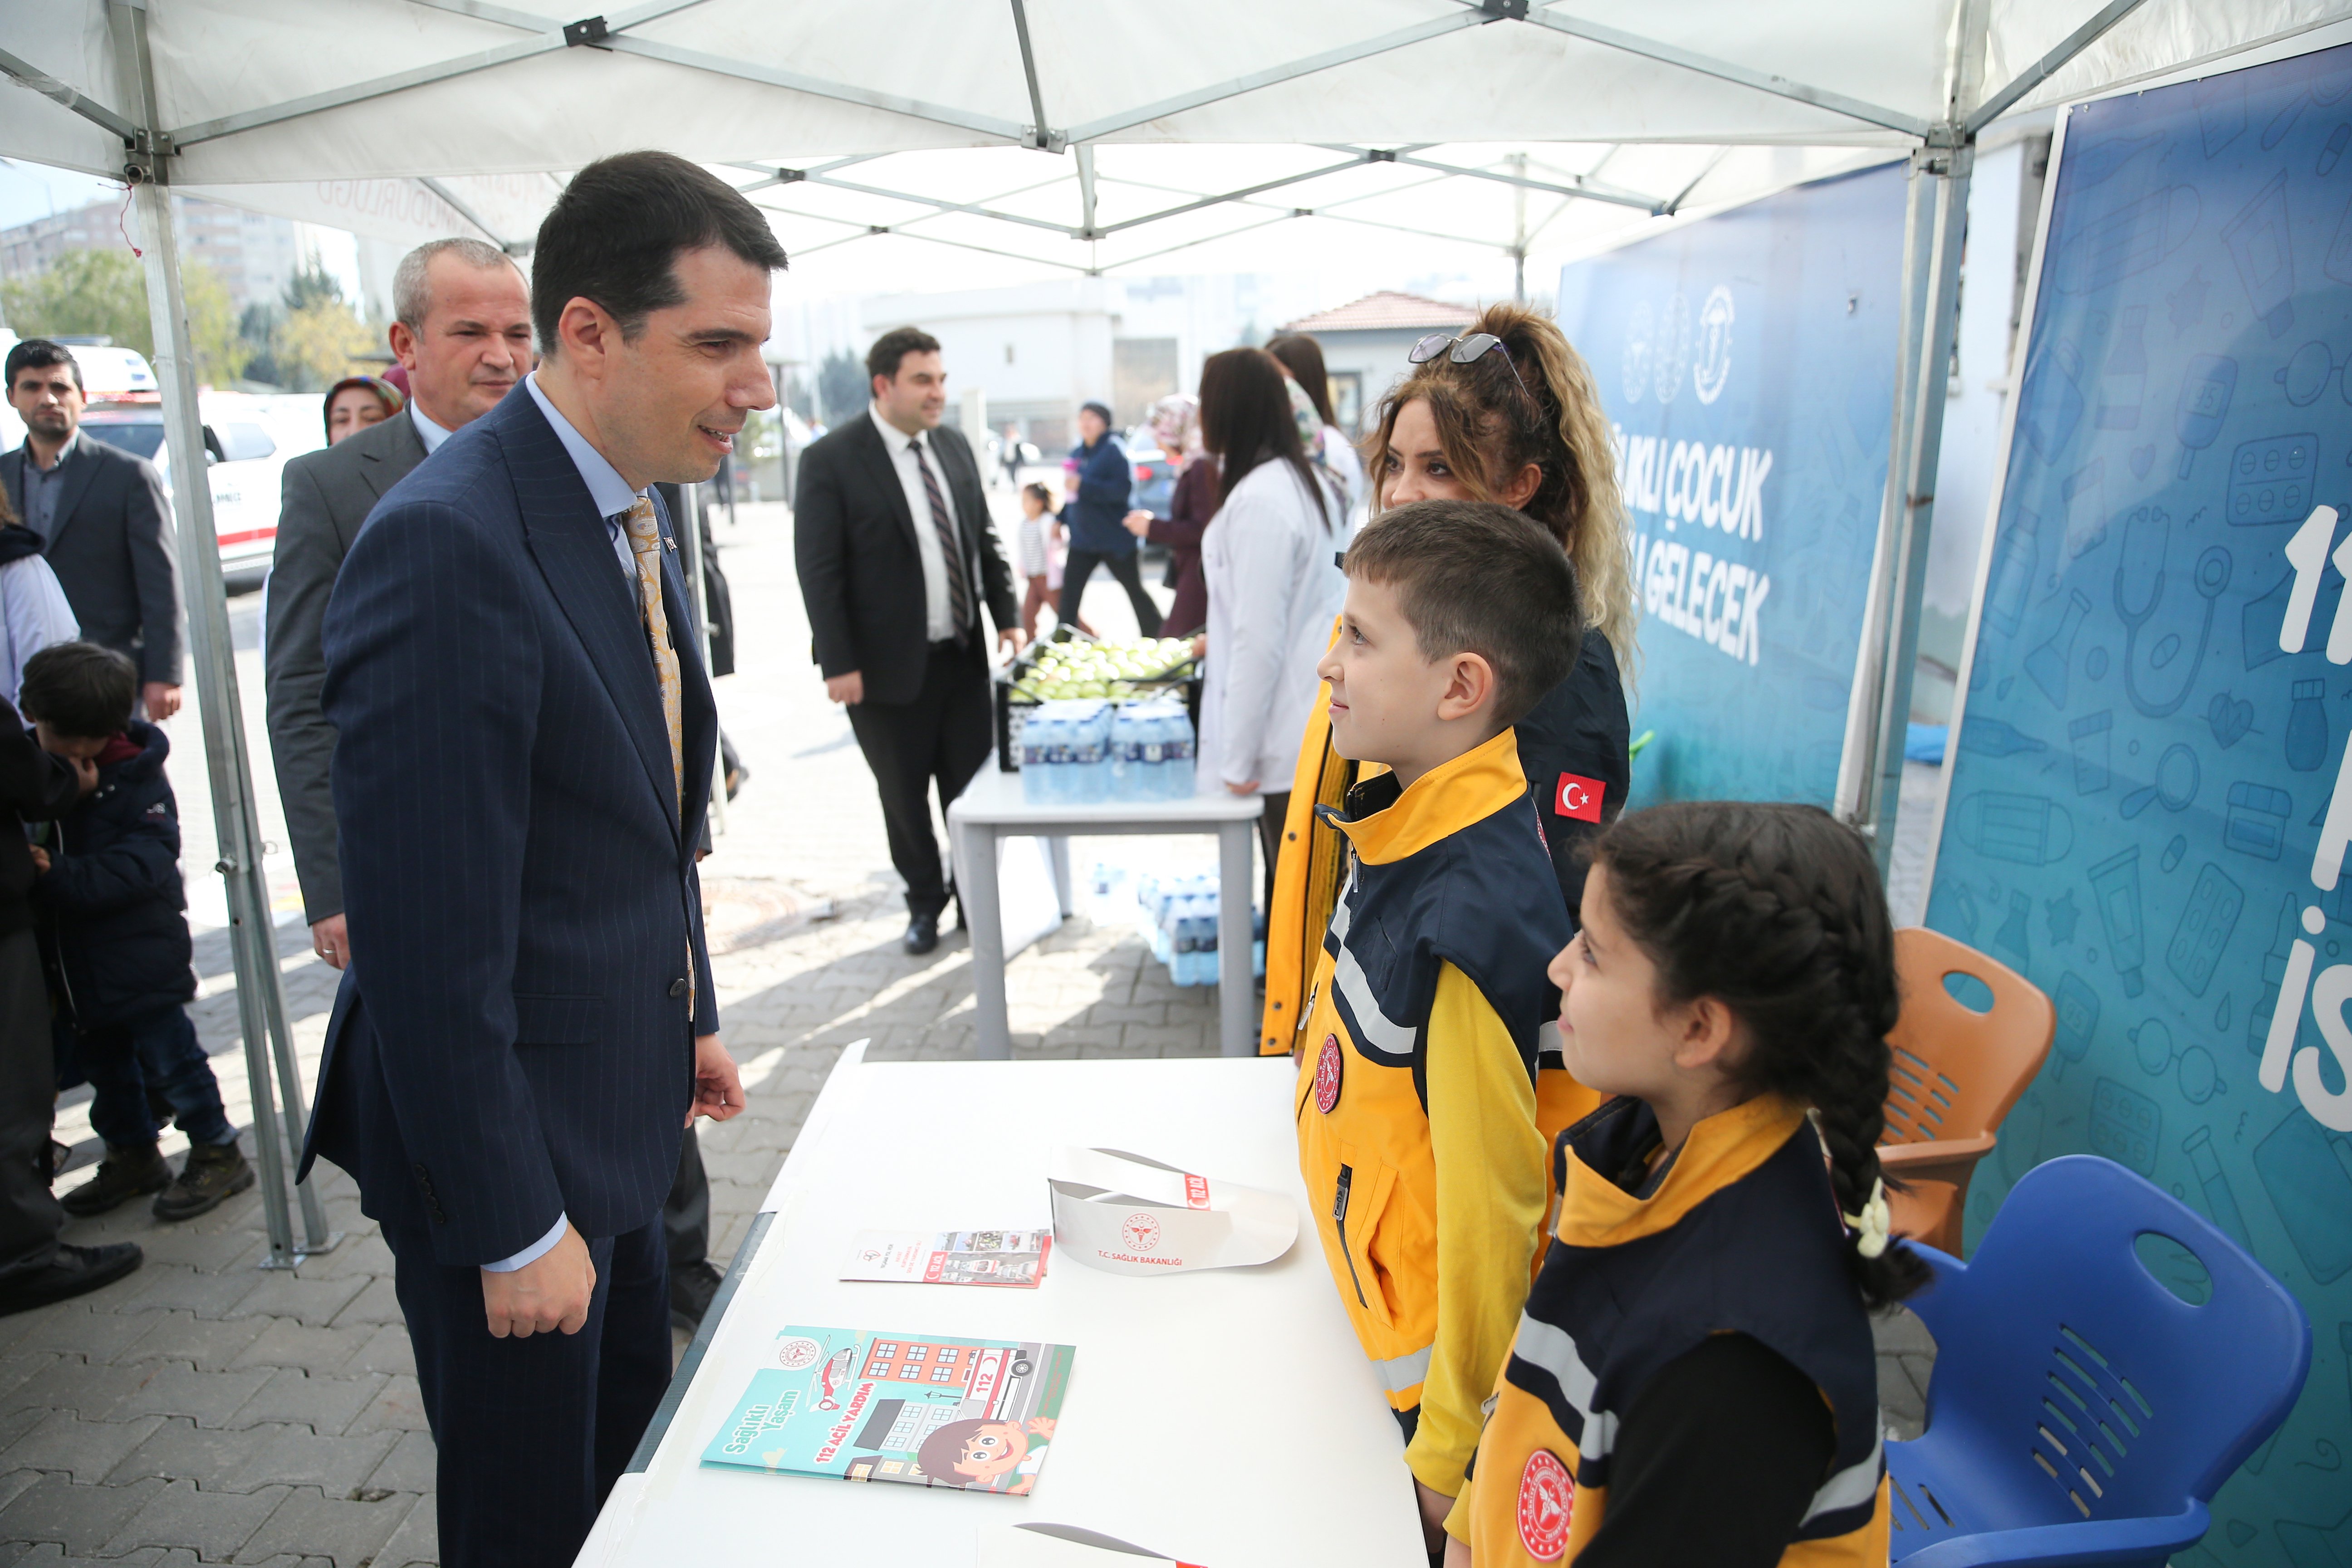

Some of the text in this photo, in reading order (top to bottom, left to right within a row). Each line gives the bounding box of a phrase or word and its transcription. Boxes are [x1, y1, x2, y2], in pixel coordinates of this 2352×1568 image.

[1665, 439, 1774, 543] ÇOCUK
[1644, 539, 1770, 667] GELECEK
[1191, 1189, 1206, 1199] 112
[1098, 1250, 1183, 1266] T.C. SAĞLIK BAKANLIĞI
[976, 1373, 993, 1392] 112
[725, 1406, 770, 1453] Sağlıklı
[760, 1391, 799, 1431] Yaşam
[816, 1382, 874, 1463] 112 ACİL YARDIM
